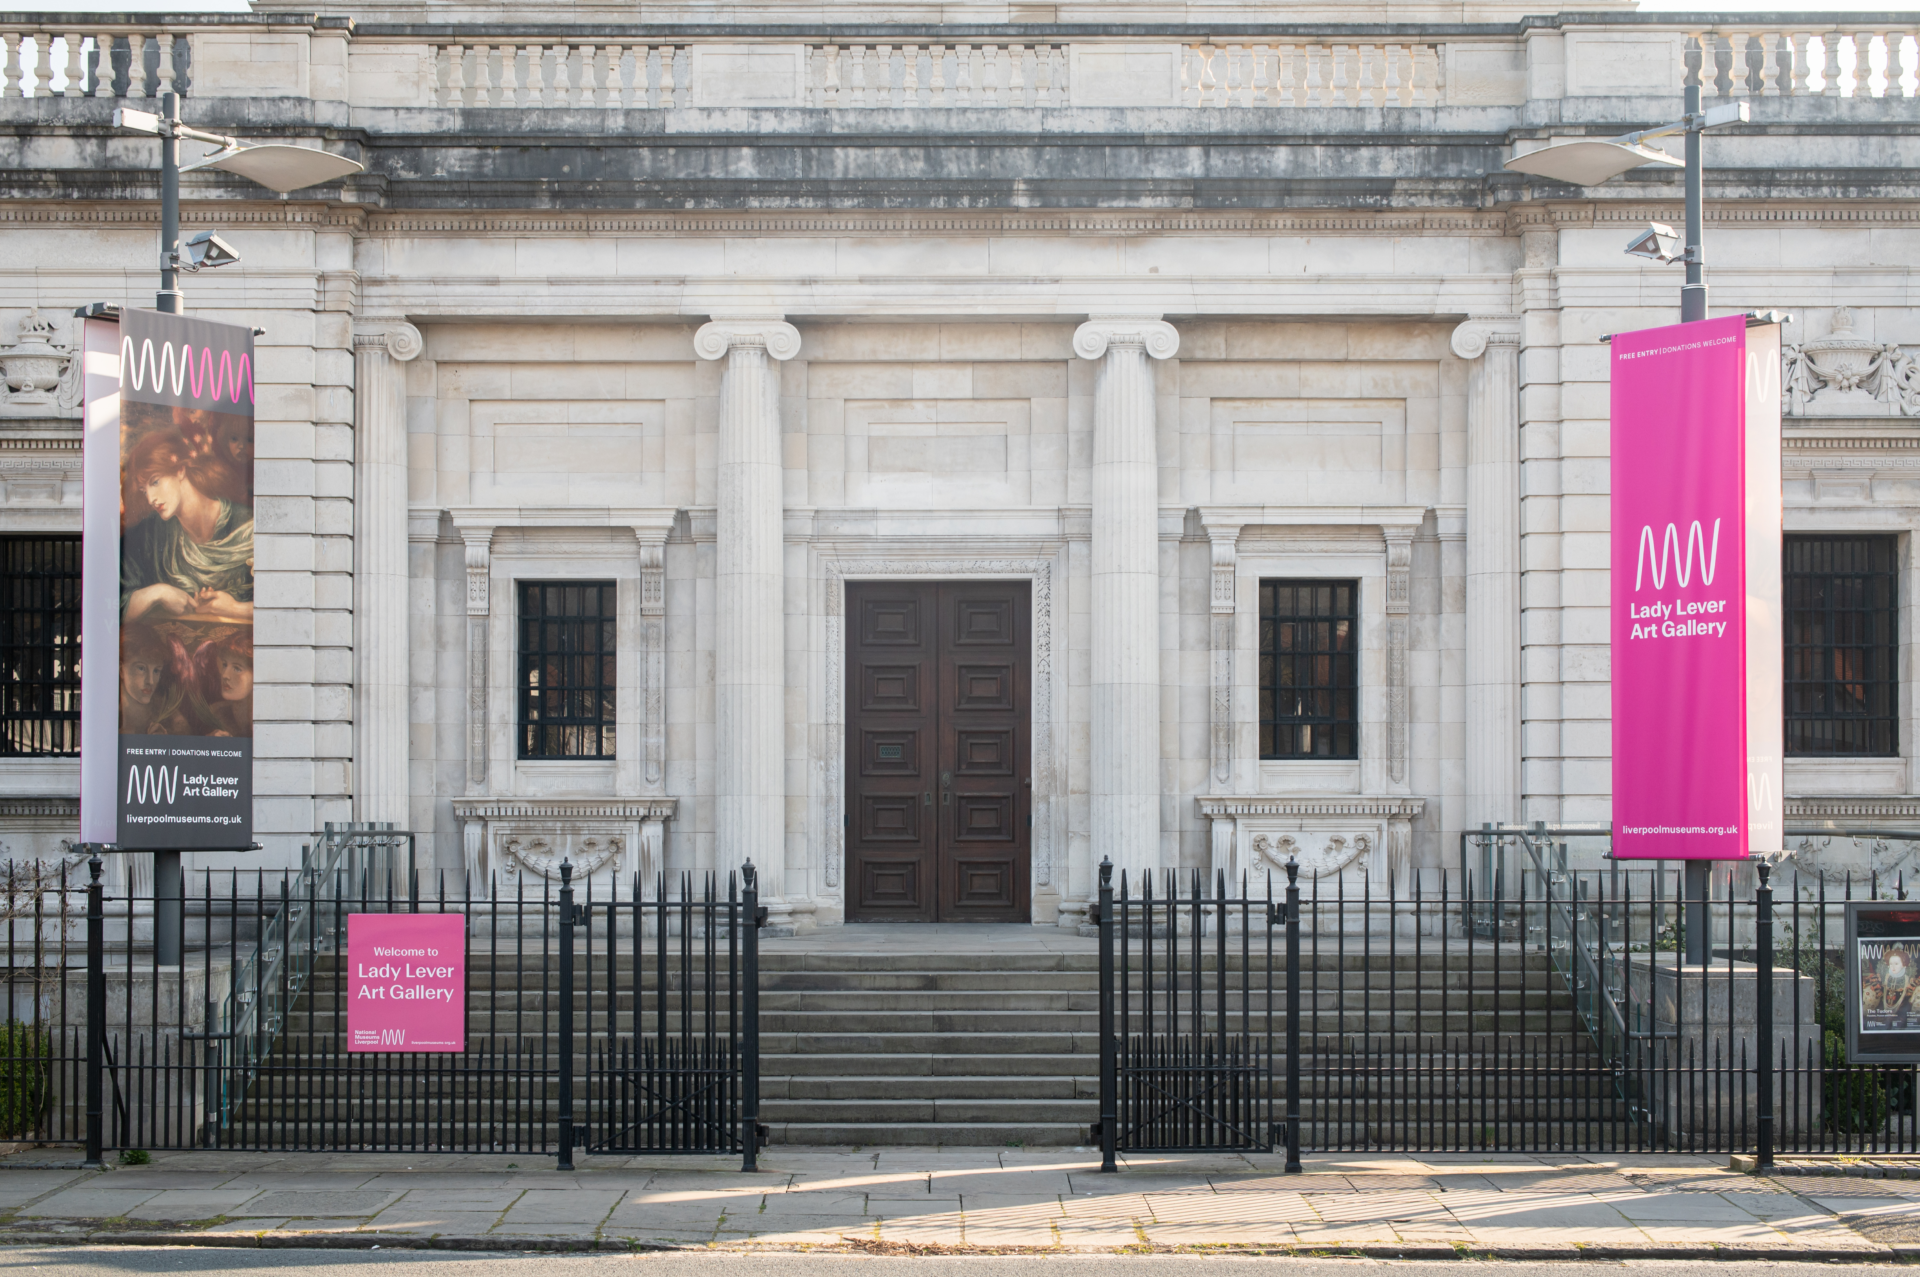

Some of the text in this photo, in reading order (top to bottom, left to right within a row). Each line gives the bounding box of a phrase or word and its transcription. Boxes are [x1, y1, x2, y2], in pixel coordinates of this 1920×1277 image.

[1637, 349, 1659, 358] ENTRY
[1663, 342, 1702, 353] DONATIONS
[1703, 335, 1737, 347] WELCOME
[1630, 599, 1726, 620] Lady Lever
[1630, 619, 1727, 640] Art Gallery
[145, 748, 167, 756] ENTRY
[172, 749, 210, 757] DONATIONS
[183, 774, 239, 786] Lady Lever
[183, 786, 238, 799] Art Gallery
[127, 814, 242, 825] liverpoolmuseums.org.uk
[1623, 825, 1738, 835] liverpoolmuseums.org.uk
[374, 947, 438, 956] Welcome to
[359, 963, 454, 981] Lady Lever
[358, 985, 454, 1002] Art Gallery
